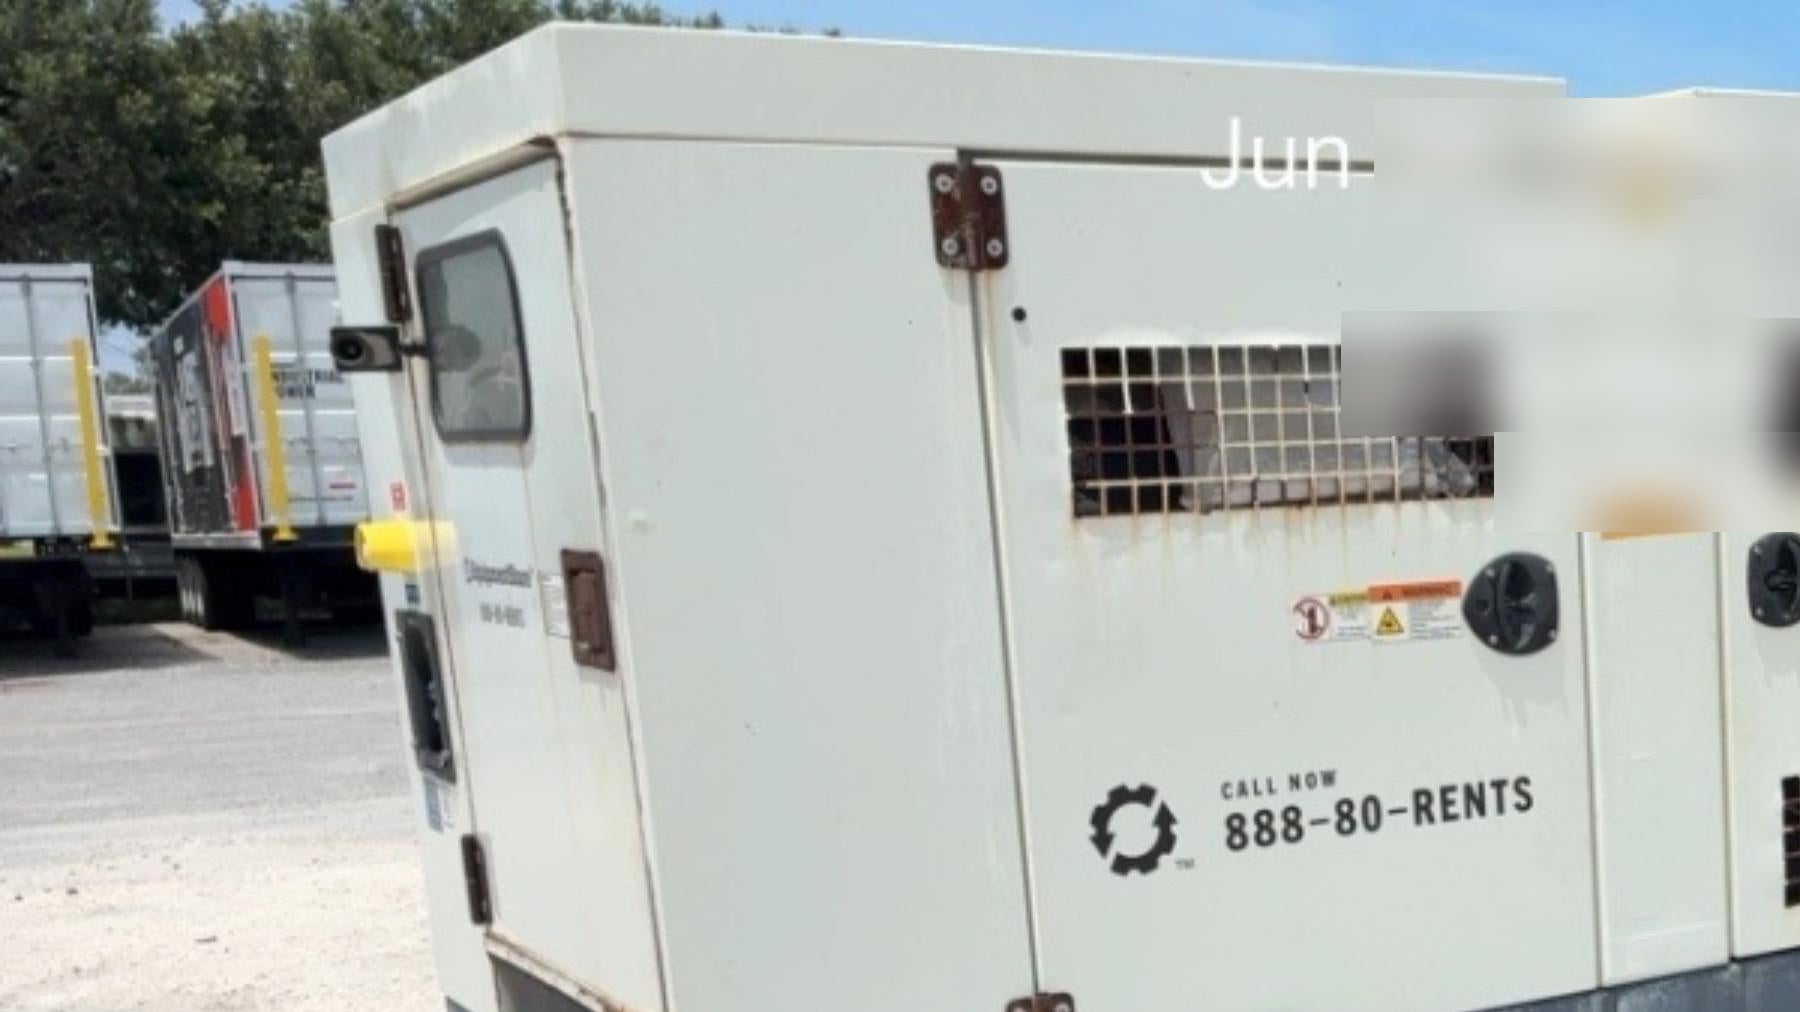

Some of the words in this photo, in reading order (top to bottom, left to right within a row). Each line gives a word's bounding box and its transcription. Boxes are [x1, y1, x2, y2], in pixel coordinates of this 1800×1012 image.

[1220, 777, 1277, 800] CALL
[1288, 769, 1338, 791] NOW
[1224, 775, 1535, 852] 888-80-RENTS
